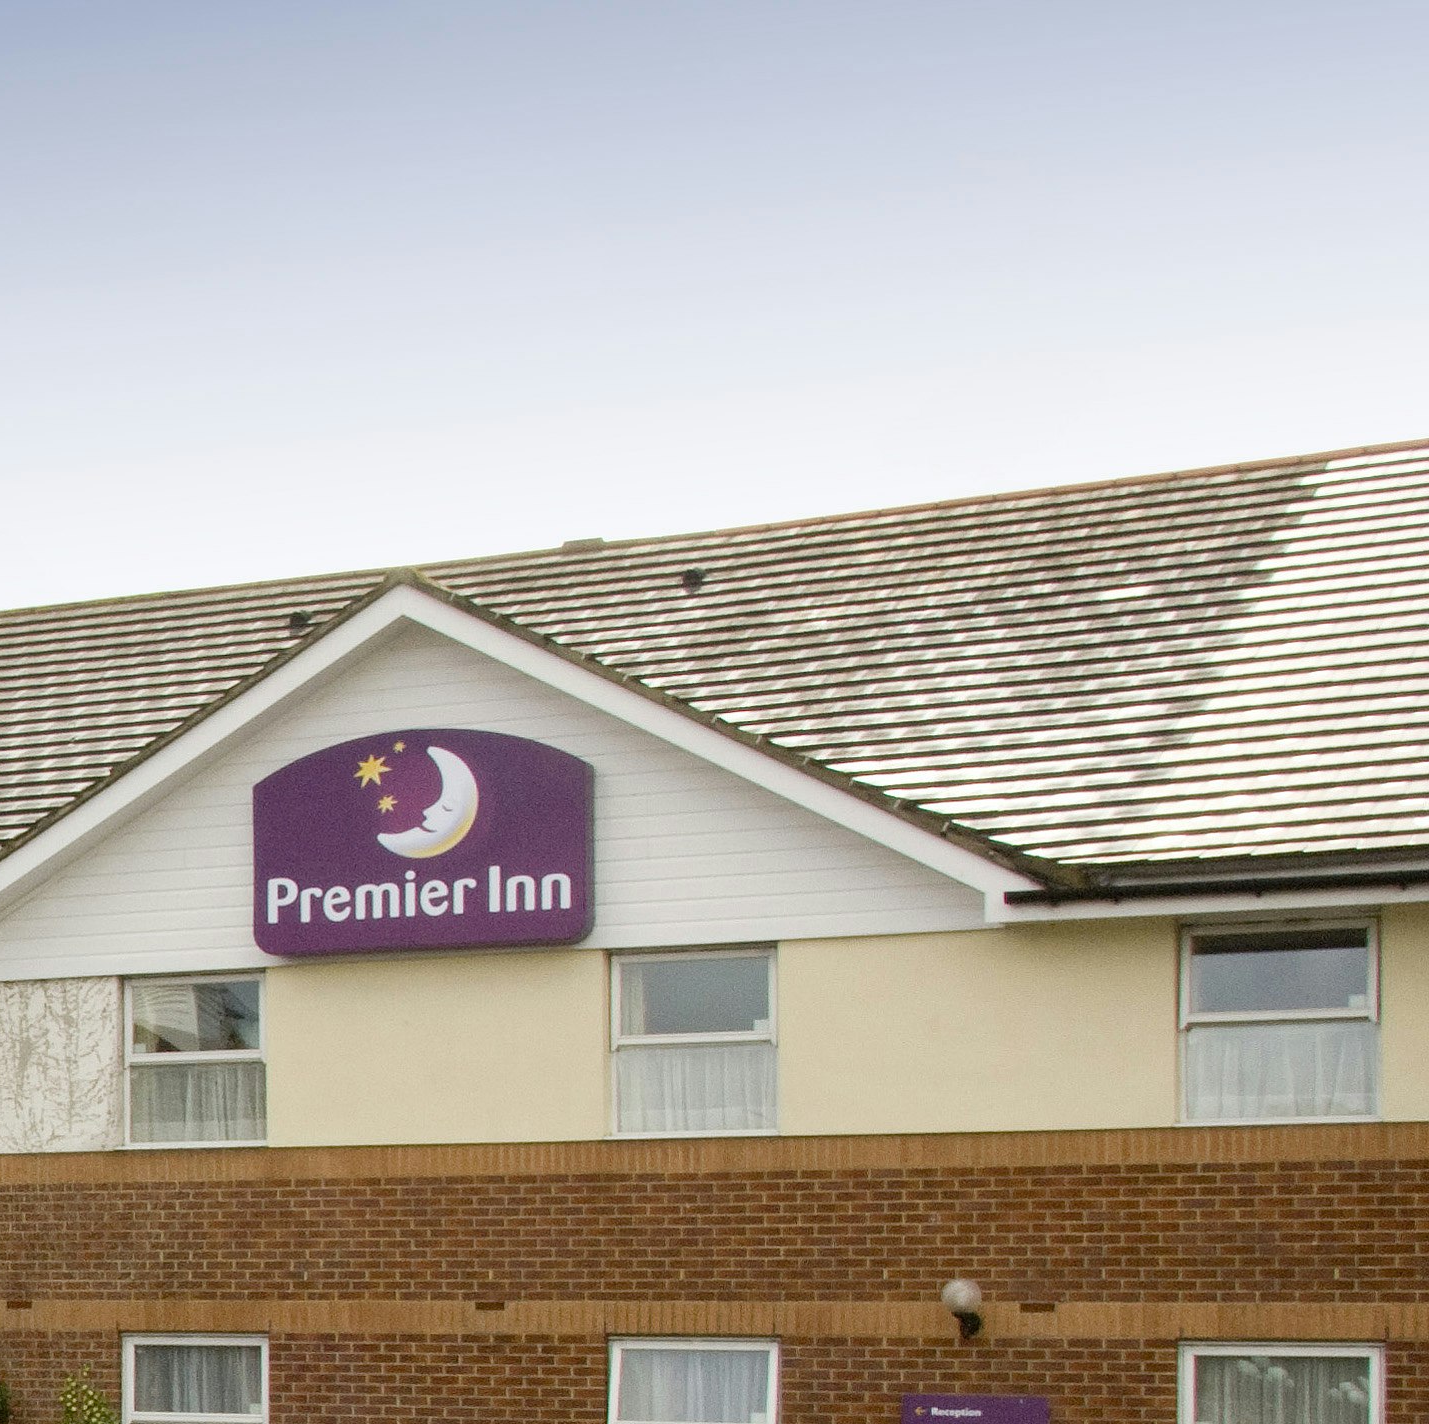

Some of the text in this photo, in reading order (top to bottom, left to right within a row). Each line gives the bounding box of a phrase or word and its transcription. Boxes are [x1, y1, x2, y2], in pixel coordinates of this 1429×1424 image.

[266, 865, 572, 925] Premier Inn
[931, 1406, 982, 1419] Reception
